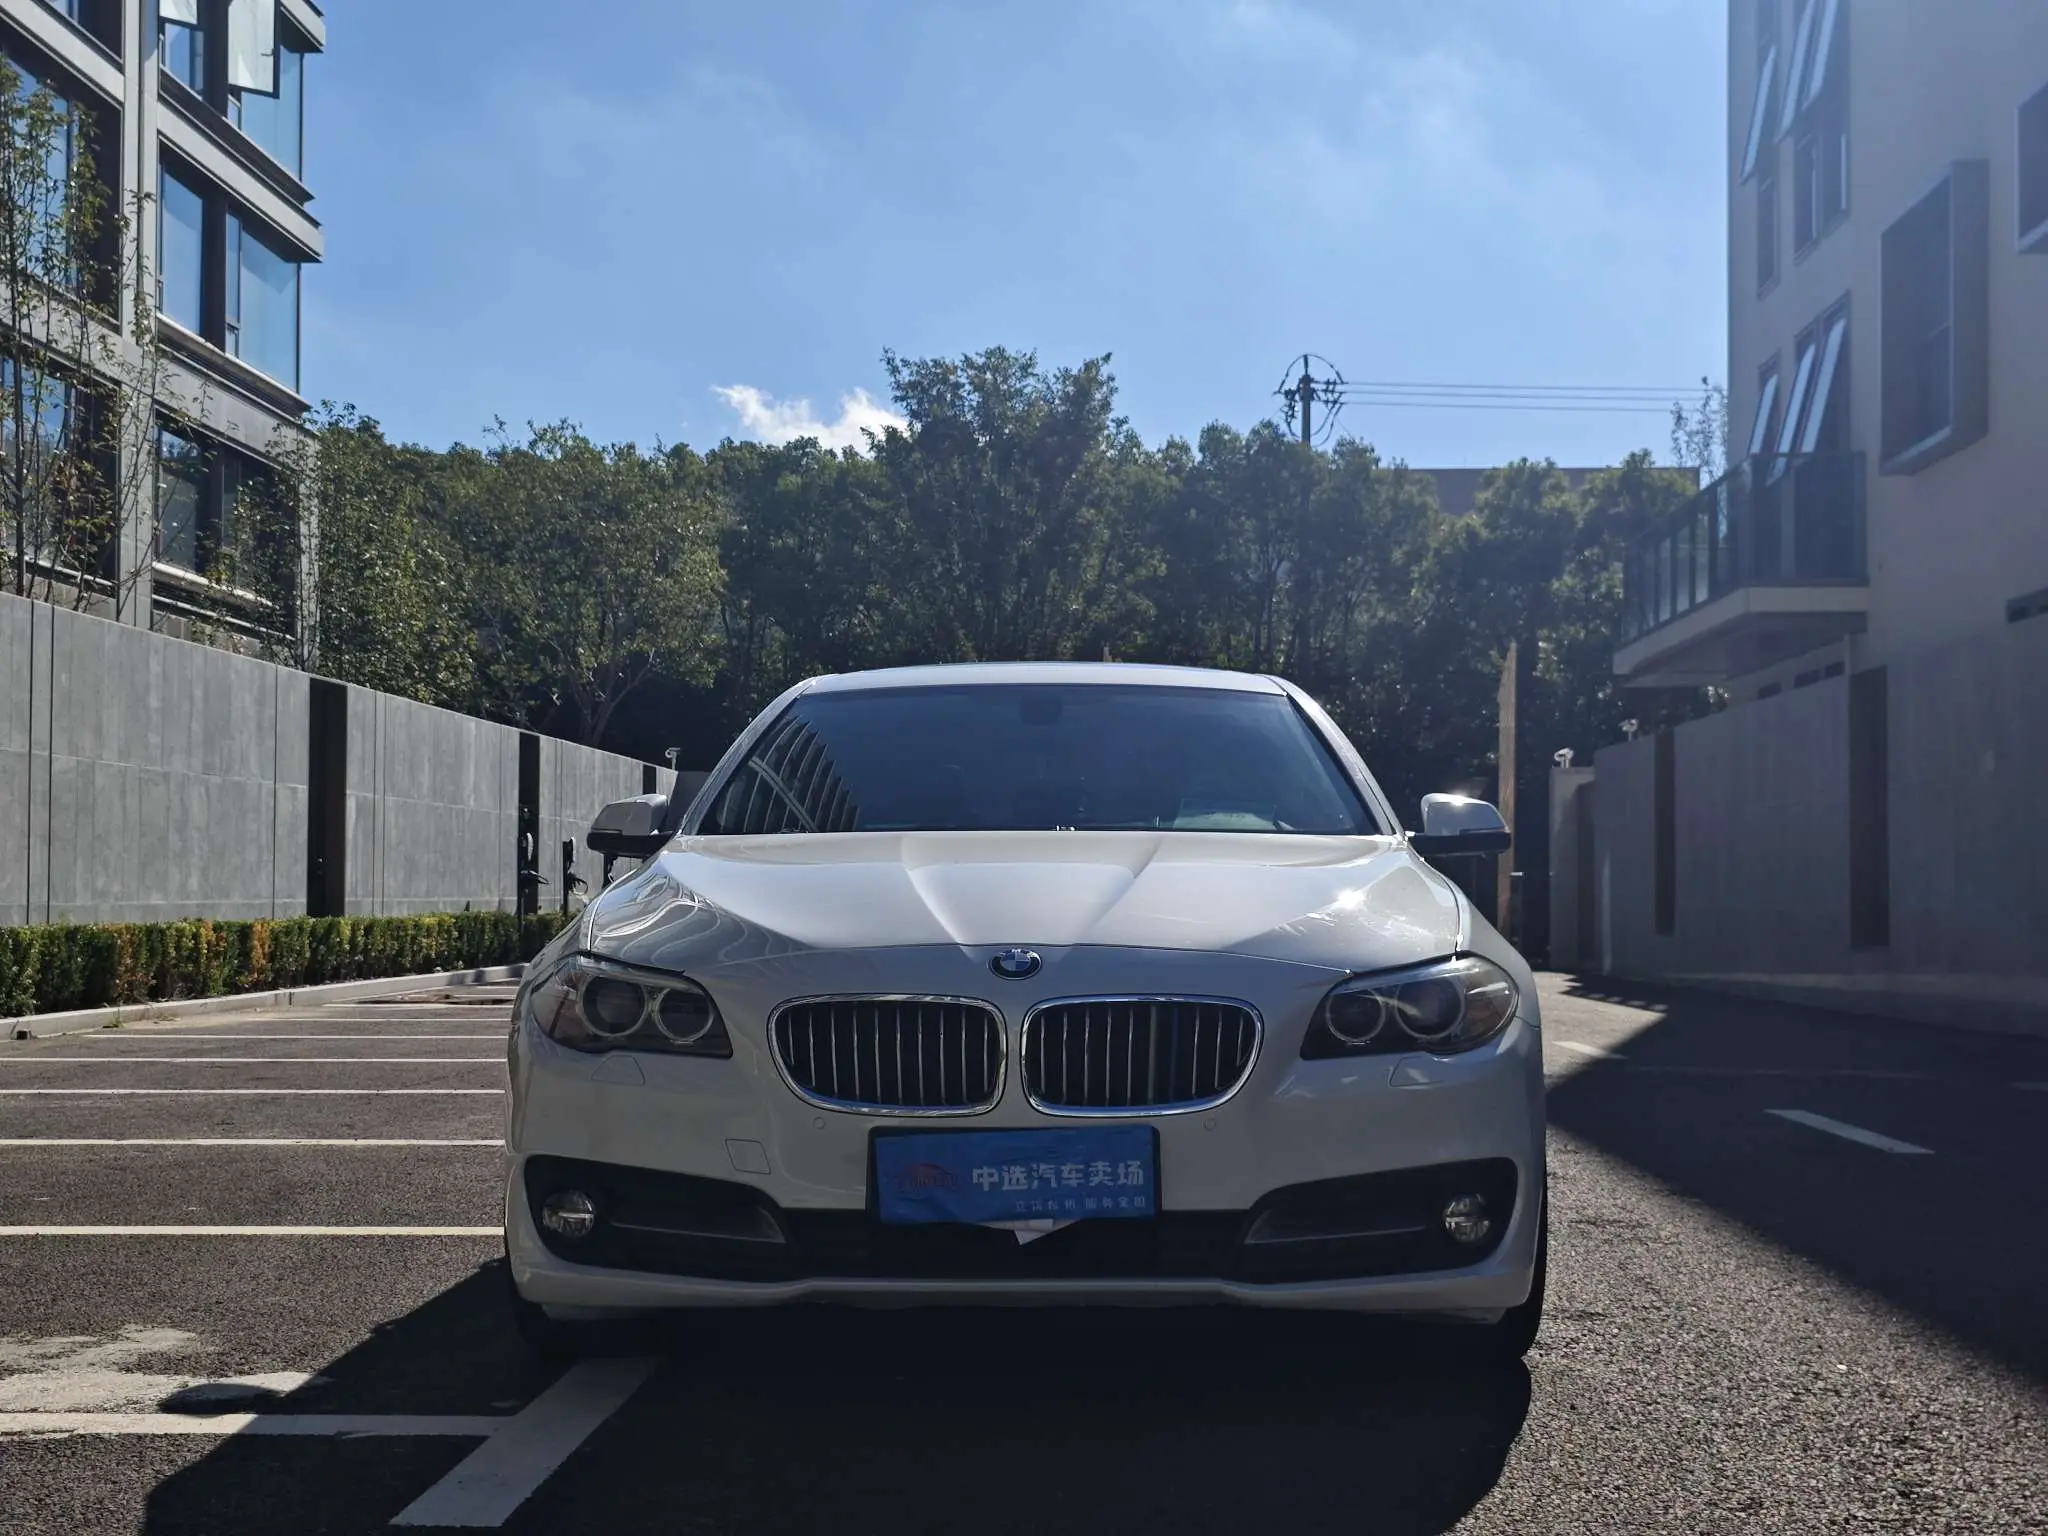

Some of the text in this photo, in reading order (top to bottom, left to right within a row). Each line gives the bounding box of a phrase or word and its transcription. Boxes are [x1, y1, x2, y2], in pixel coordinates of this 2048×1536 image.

[971, 1160, 1144, 1191] 中选汽车卖场
